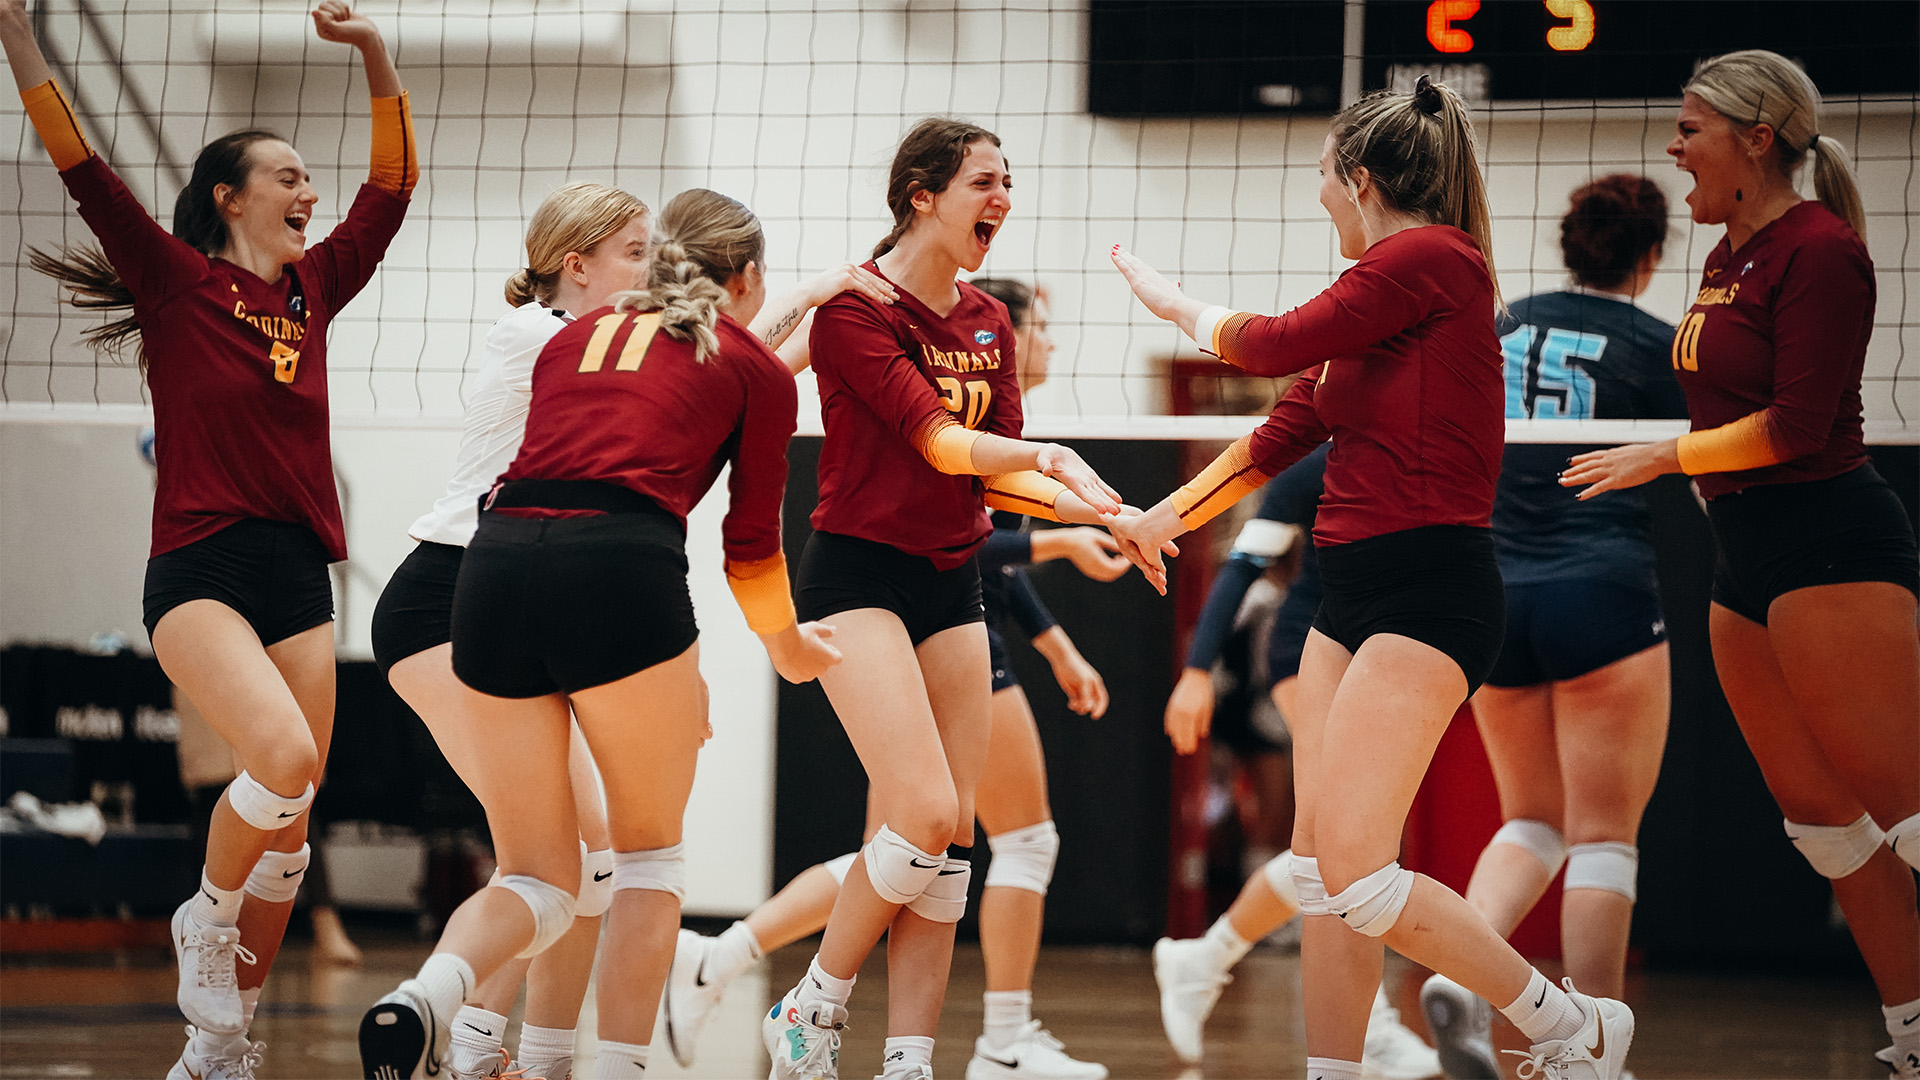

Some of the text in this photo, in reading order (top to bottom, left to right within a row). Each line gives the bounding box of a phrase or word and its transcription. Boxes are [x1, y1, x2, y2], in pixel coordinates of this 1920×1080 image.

[577, 312, 662, 373] 11
[1500, 324, 1608, 420] 15
[935, 376, 992, 431] 20
